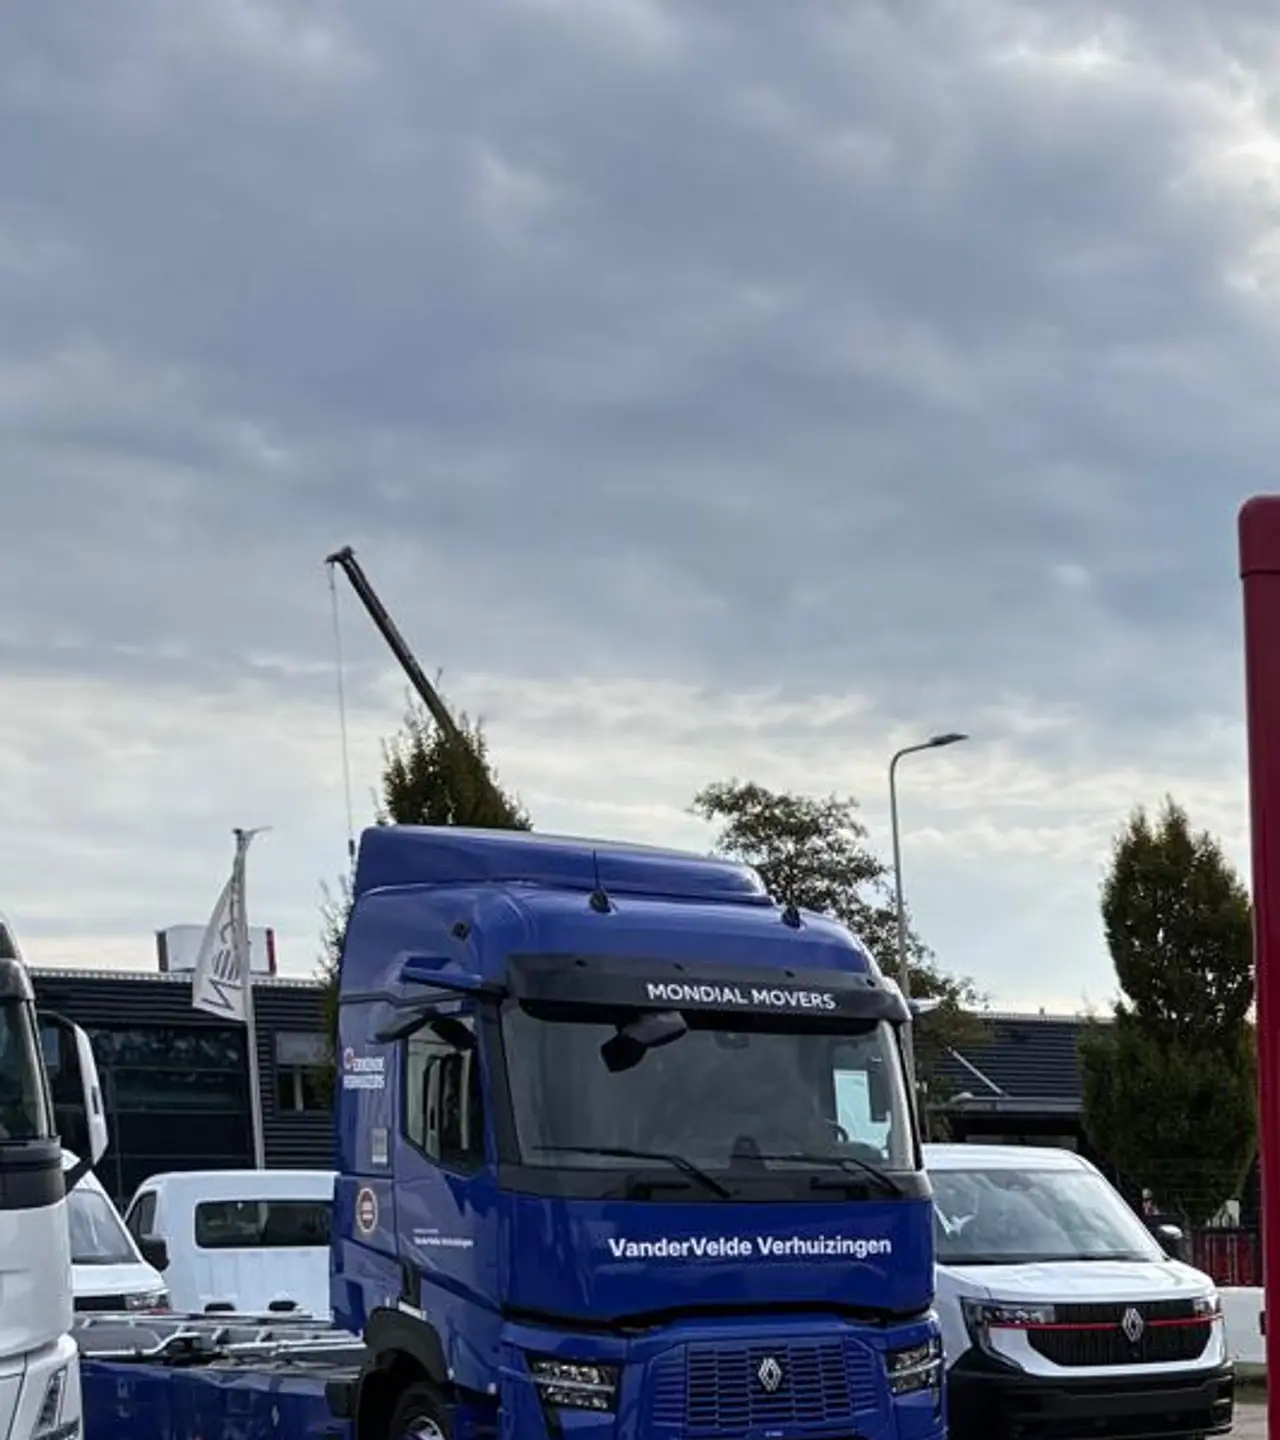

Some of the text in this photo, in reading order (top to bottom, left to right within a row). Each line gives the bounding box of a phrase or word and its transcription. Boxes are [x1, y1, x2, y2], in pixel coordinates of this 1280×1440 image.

[645, 983, 836, 1010] MONDIAL MOVERS
[608, 1235, 892, 1259] VanderVelde Verhuizingen
